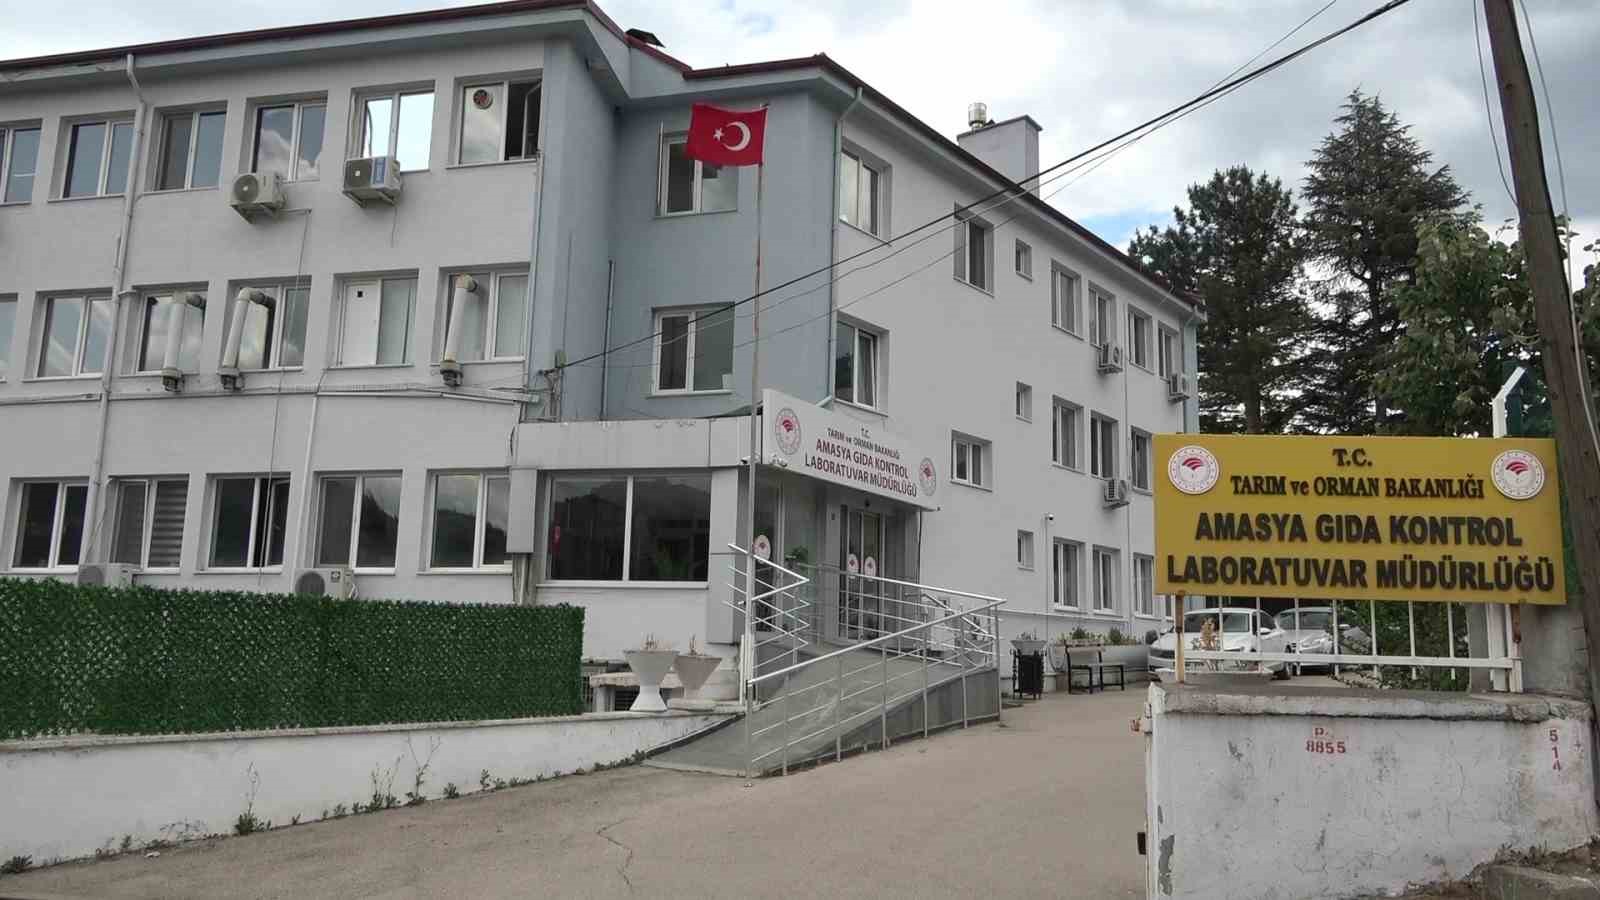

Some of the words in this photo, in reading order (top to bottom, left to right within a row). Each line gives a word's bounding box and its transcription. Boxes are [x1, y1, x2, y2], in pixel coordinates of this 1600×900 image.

[827, 427, 845, 442] TARIM
[853, 438, 874, 449] ORMAN
[816, 439, 852, 461] AMASYA
[853, 451, 874, 468] GIDA
[875, 458, 909, 479] KONTROL
[1332, 448, 1373, 467] T.C.
[805, 453, 869, 483] LABORATUVAR
[870, 472, 917, 498] MÜDÜRLÜĞÜ
[1230, 475, 1287, 496] TARIM
[1289, 481, 1309, 496] ve
[1313, 476, 1379, 497] ORMAN
[1384, 473, 1485, 499] BAKANLIĞI
[1195, 512, 1308, 543] AMASYA
[1315, 513, 1382, 544] GIDA
[1389, 515, 1523, 547] KONTROL
[1167, 555, 1368, 589] LABORATUVAR
[1376, 553, 1555, 592] MÜDÜRLÜĞÜ
